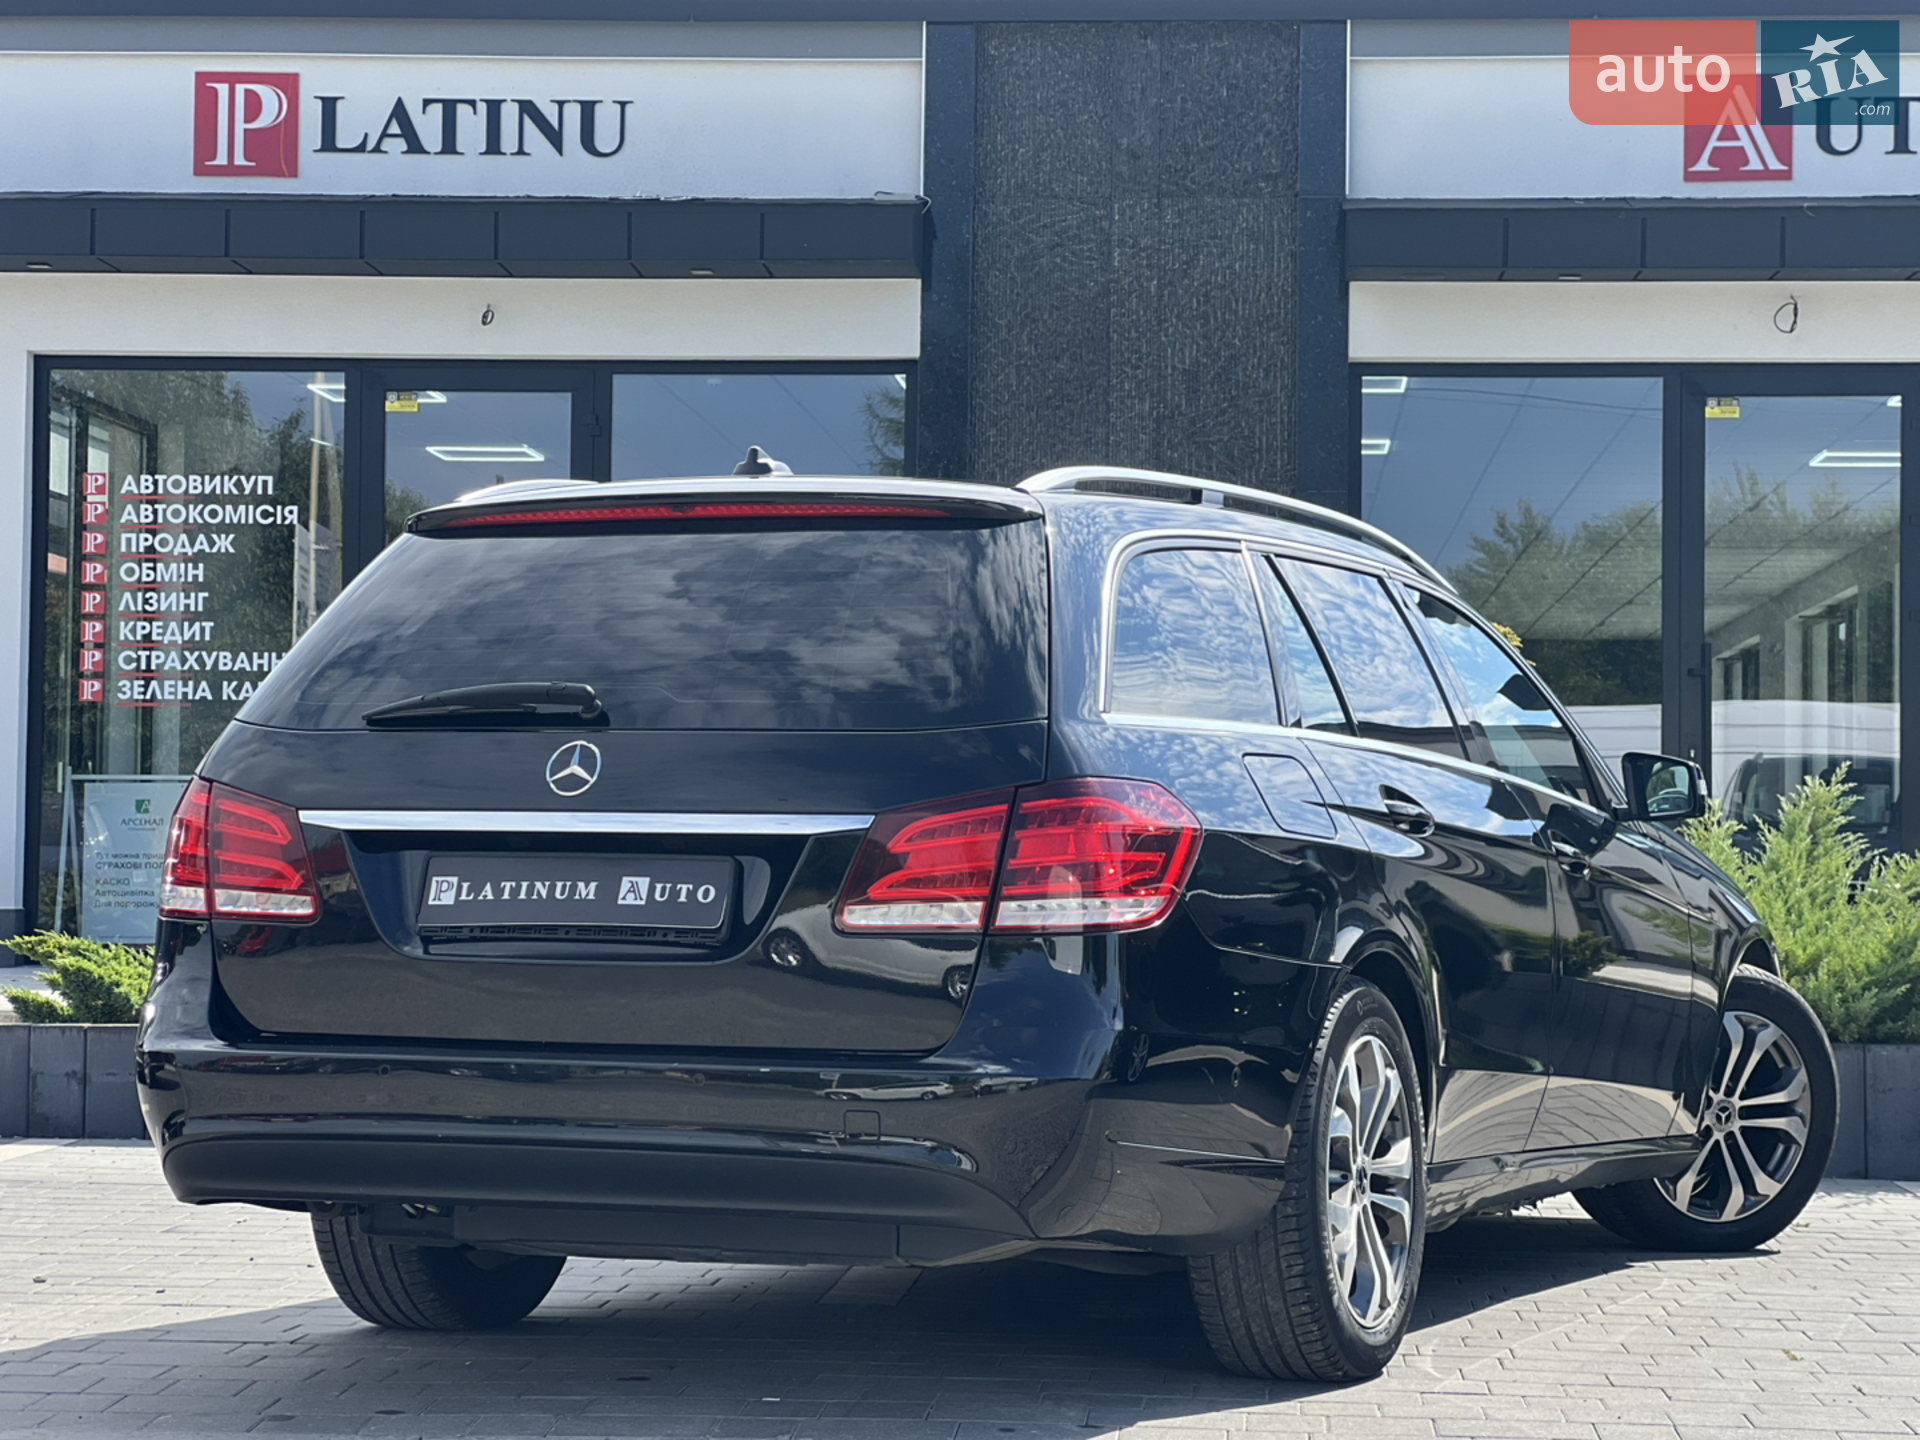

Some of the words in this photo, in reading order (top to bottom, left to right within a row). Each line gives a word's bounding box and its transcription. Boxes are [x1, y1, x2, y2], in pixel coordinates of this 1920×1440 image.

[120, 474, 274, 496] АВТОВИКУП
[120, 504, 299, 525] АВТОКОМІСІЯ
[120, 534, 236, 556] ПРОДАЖ
[119, 562, 204, 583] ОБМІН
[118, 592, 209, 612] ЛІЗИНГ
[118, 621, 214, 643] КРЕДИТ
[117, 680, 212, 700] ЗЕЛЕНА
[120, 817, 164, 827] АРСЕНАЛ
[95, 861, 142, 870] СТРАХОВІ
[95, 877, 130, 886] КАСКО
[428, 876, 599, 905] PLATINUM
[617, 876, 716, 905] AUTO
